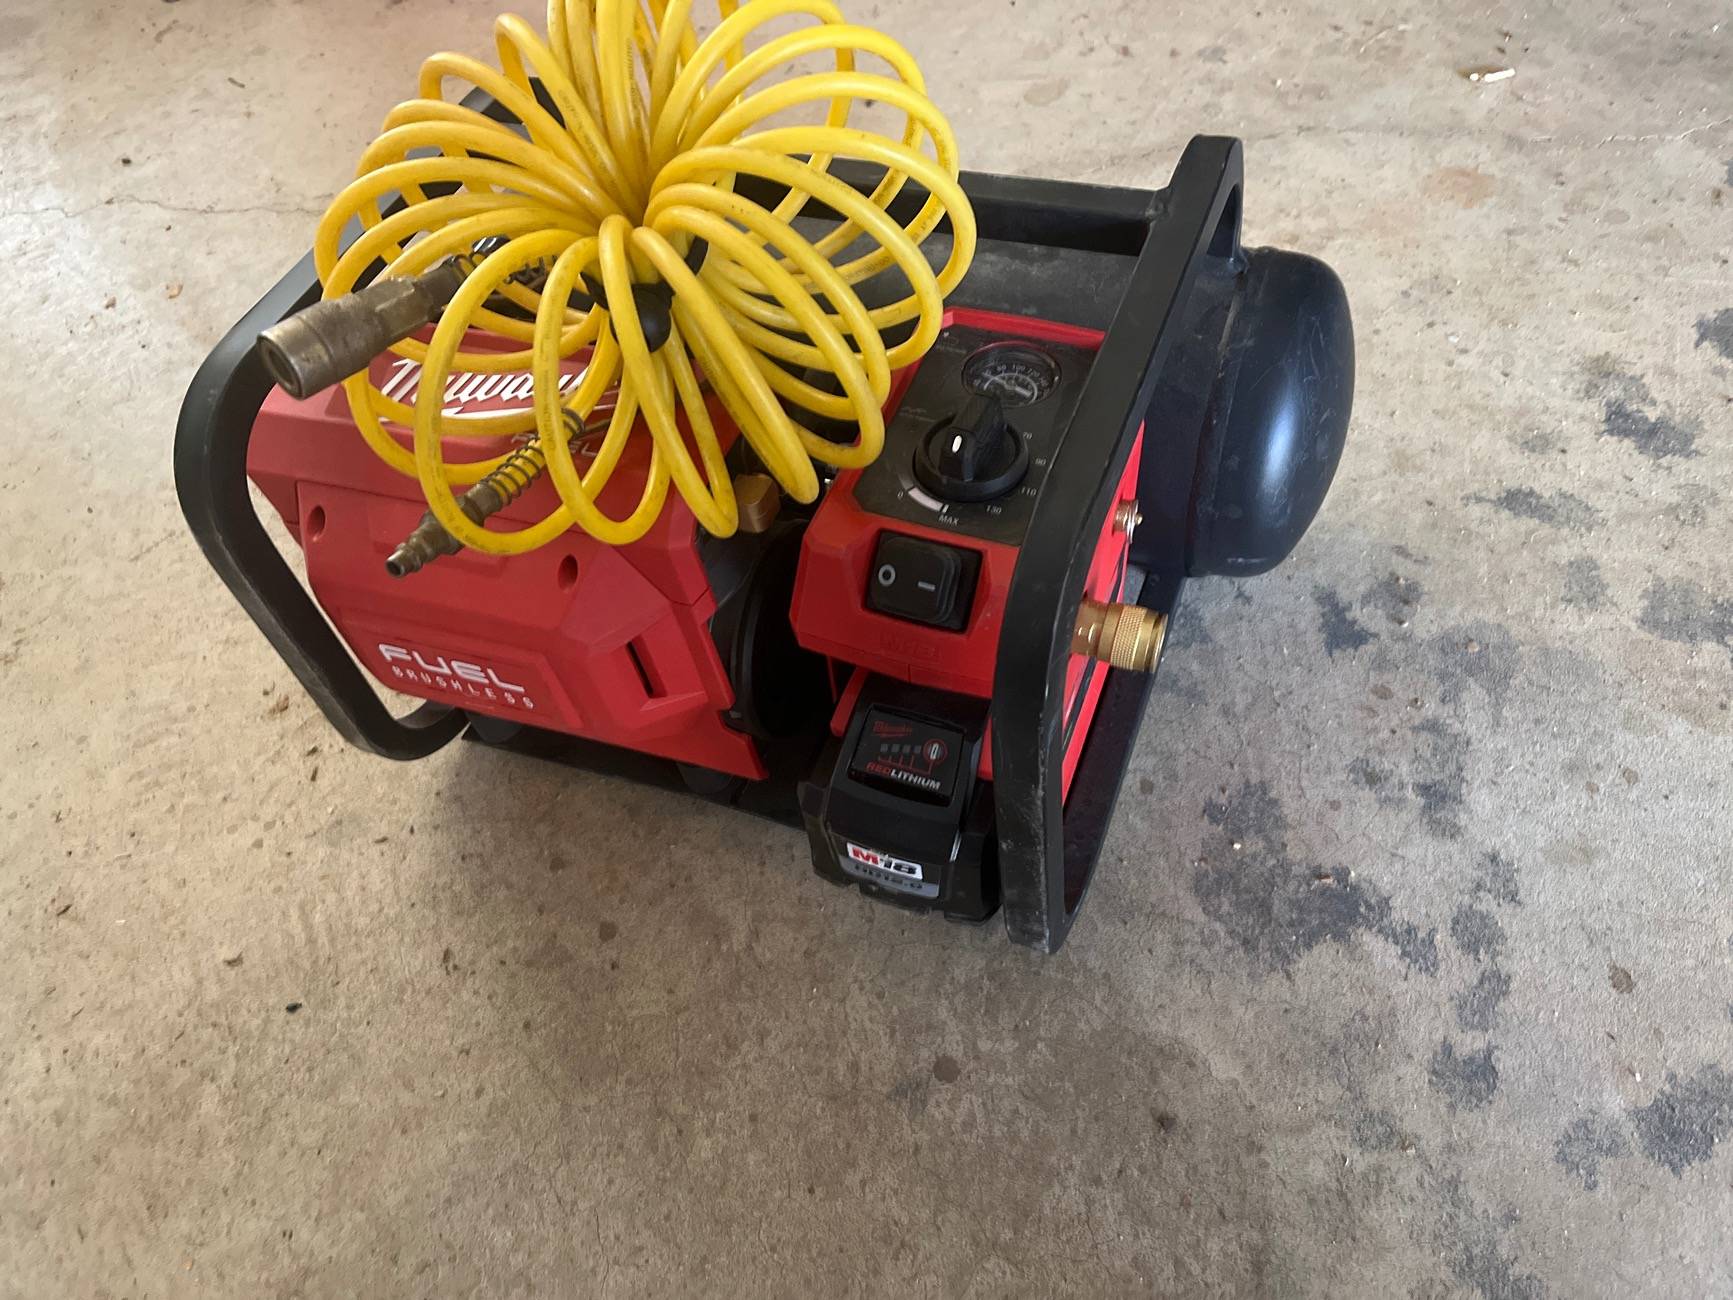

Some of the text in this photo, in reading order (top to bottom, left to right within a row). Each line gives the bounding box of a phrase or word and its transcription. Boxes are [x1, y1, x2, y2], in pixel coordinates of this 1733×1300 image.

[1023, 431, 1033, 440] 70
[1035, 457, 1047, 466] 90
[1020, 487, 1037, 496] 110
[986, 505, 1002, 514] 130
[938, 514, 959, 526] MAX
[378, 643, 525, 694] FUEL
[391, 665, 534, 710] BRUSHLESS
[866, 761, 941, 791] REDLITHIUM
[851, 846, 917, 876] M18
